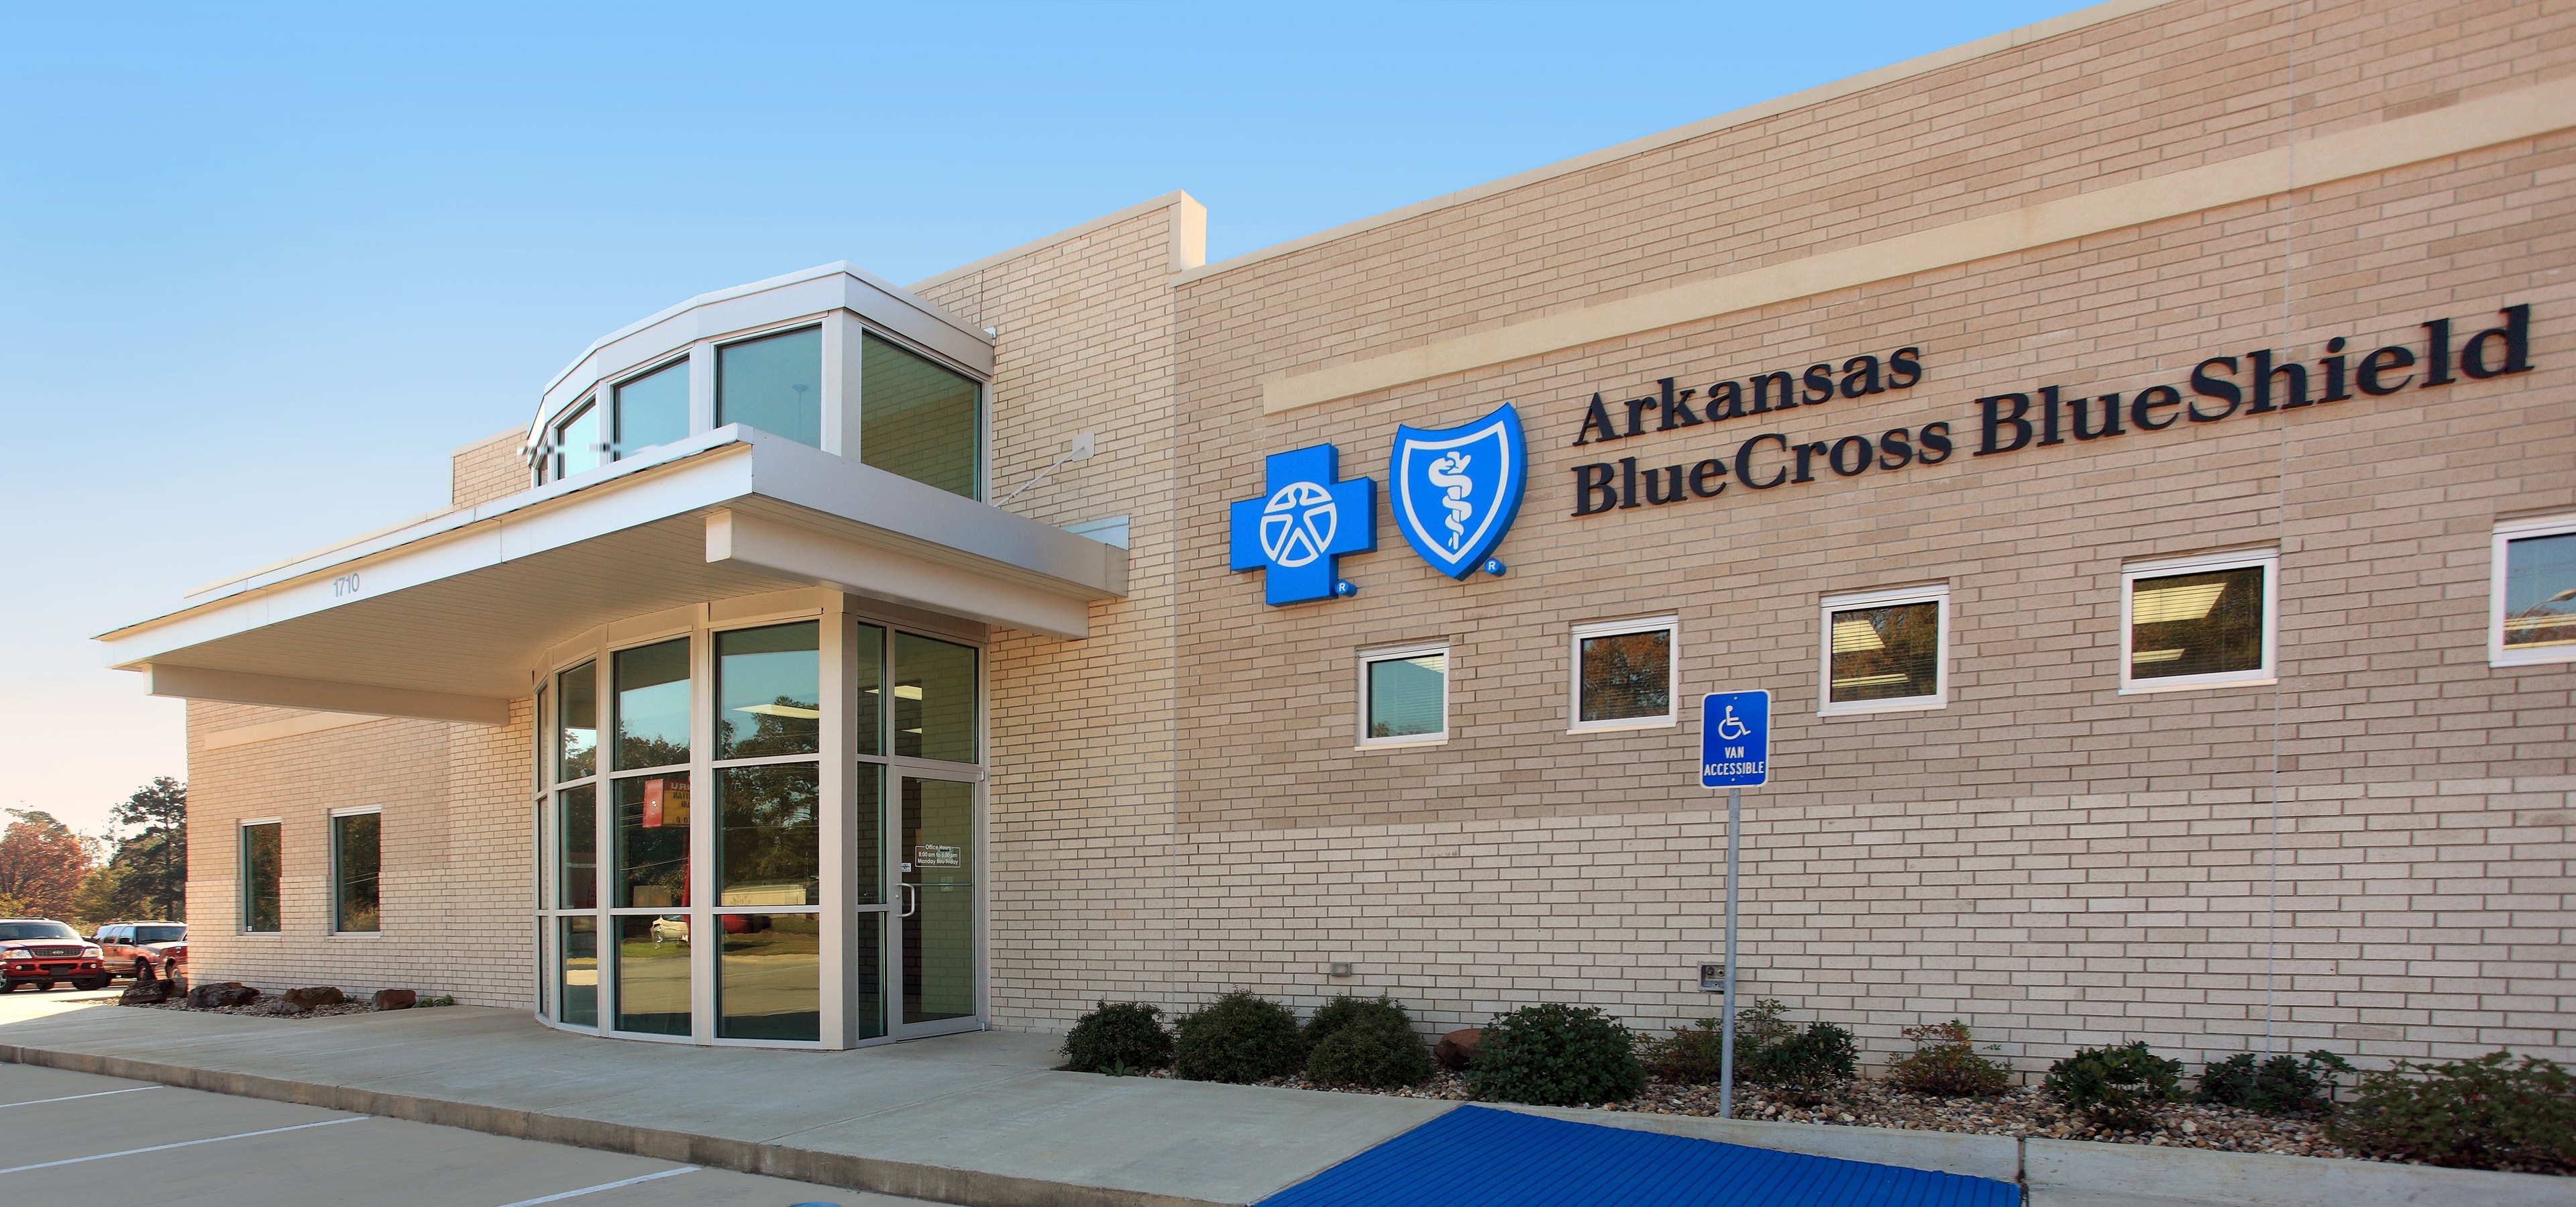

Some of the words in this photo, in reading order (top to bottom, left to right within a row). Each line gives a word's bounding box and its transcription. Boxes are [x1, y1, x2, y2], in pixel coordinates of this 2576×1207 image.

[1572, 346, 1923, 447] Arkansas
[1570, 421, 1953, 517] BlueCross
[1973, 303, 2534, 457] BlueShield
[333, 572, 360, 598] 1710
[1725, 746, 1744, 759] VAN
[1703, 762, 1764, 776] ACCESSIBLE
